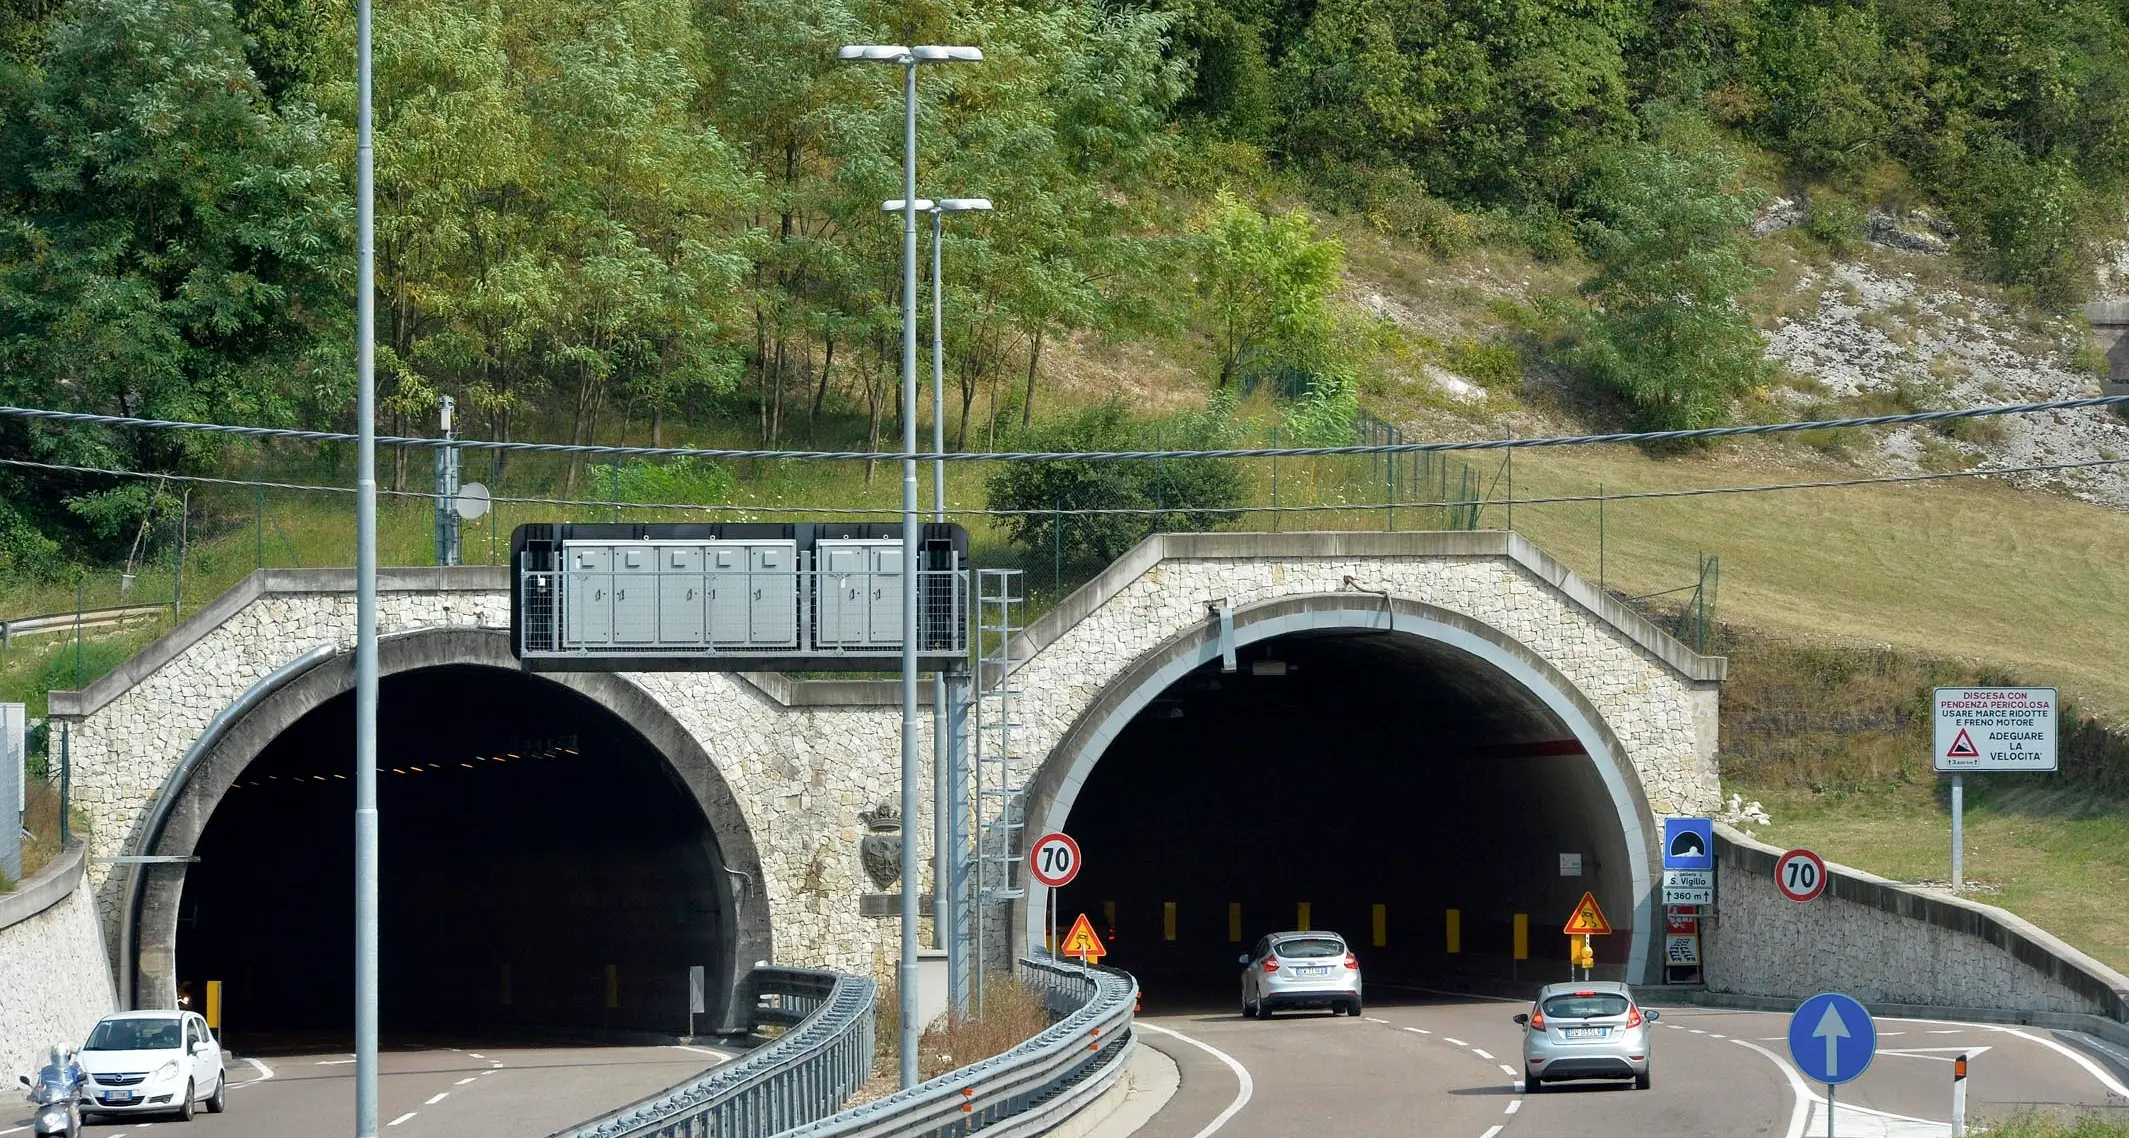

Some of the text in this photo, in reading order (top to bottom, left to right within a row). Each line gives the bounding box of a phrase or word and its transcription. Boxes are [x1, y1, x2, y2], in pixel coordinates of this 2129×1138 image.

[1963, 692, 2028, 700] DISCESA CON
[1941, 701, 2050, 709] PENDENZA PERICOLOSA
[1942, 709, 2048, 718] USARE MARCE RIDOTTE
[1956, 718, 2034, 727] E FRENO MOTORE
[1988, 732, 2044, 740] ADEGUARE
[2009, 742, 2023, 750] LA
[1042, 847, 1070, 873] 70
[1787, 862, 1815, 888] 70
[1670, 877, 1706, 886] S. Vigilio
[1673, 892, 1691, 900] 360
